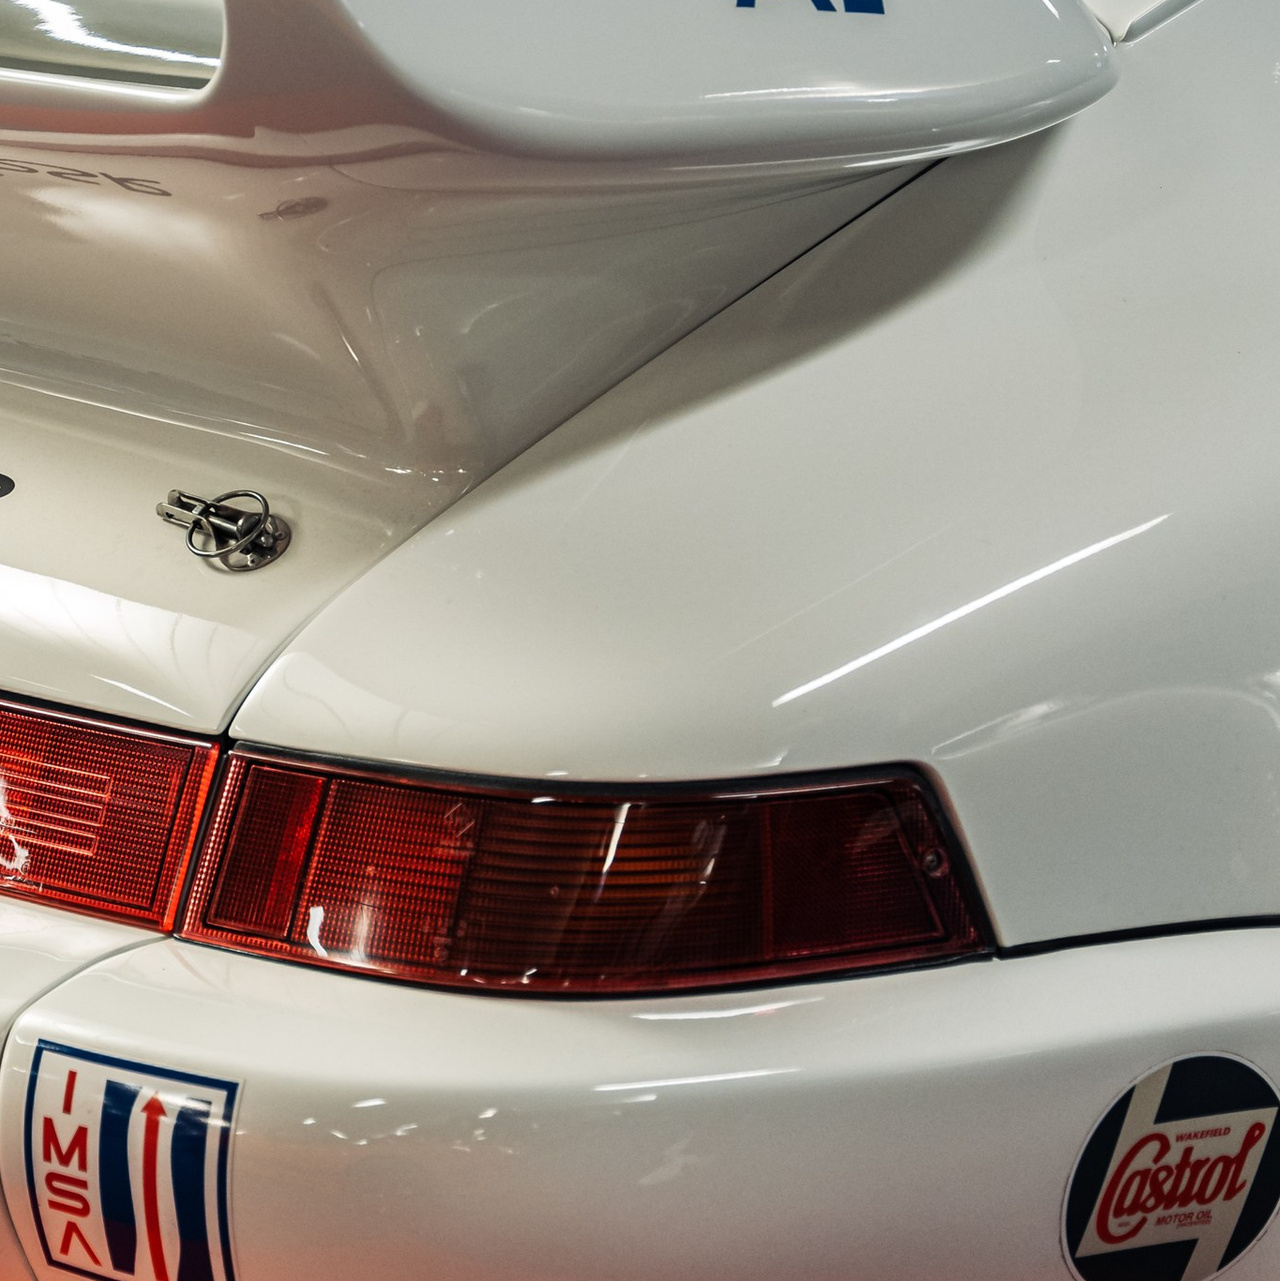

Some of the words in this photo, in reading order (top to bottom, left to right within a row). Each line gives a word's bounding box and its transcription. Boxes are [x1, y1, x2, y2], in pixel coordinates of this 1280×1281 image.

[42, 1070, 102, 1267] IMSA
[1175, 1127, 1231, 1142] WAKEFIELD
[1096, 1122, 1266, 1244] Castrol
[1155, 1212, 1193, 1226] MOTOR
[1196, 1209, 1213, 1221] OIL
